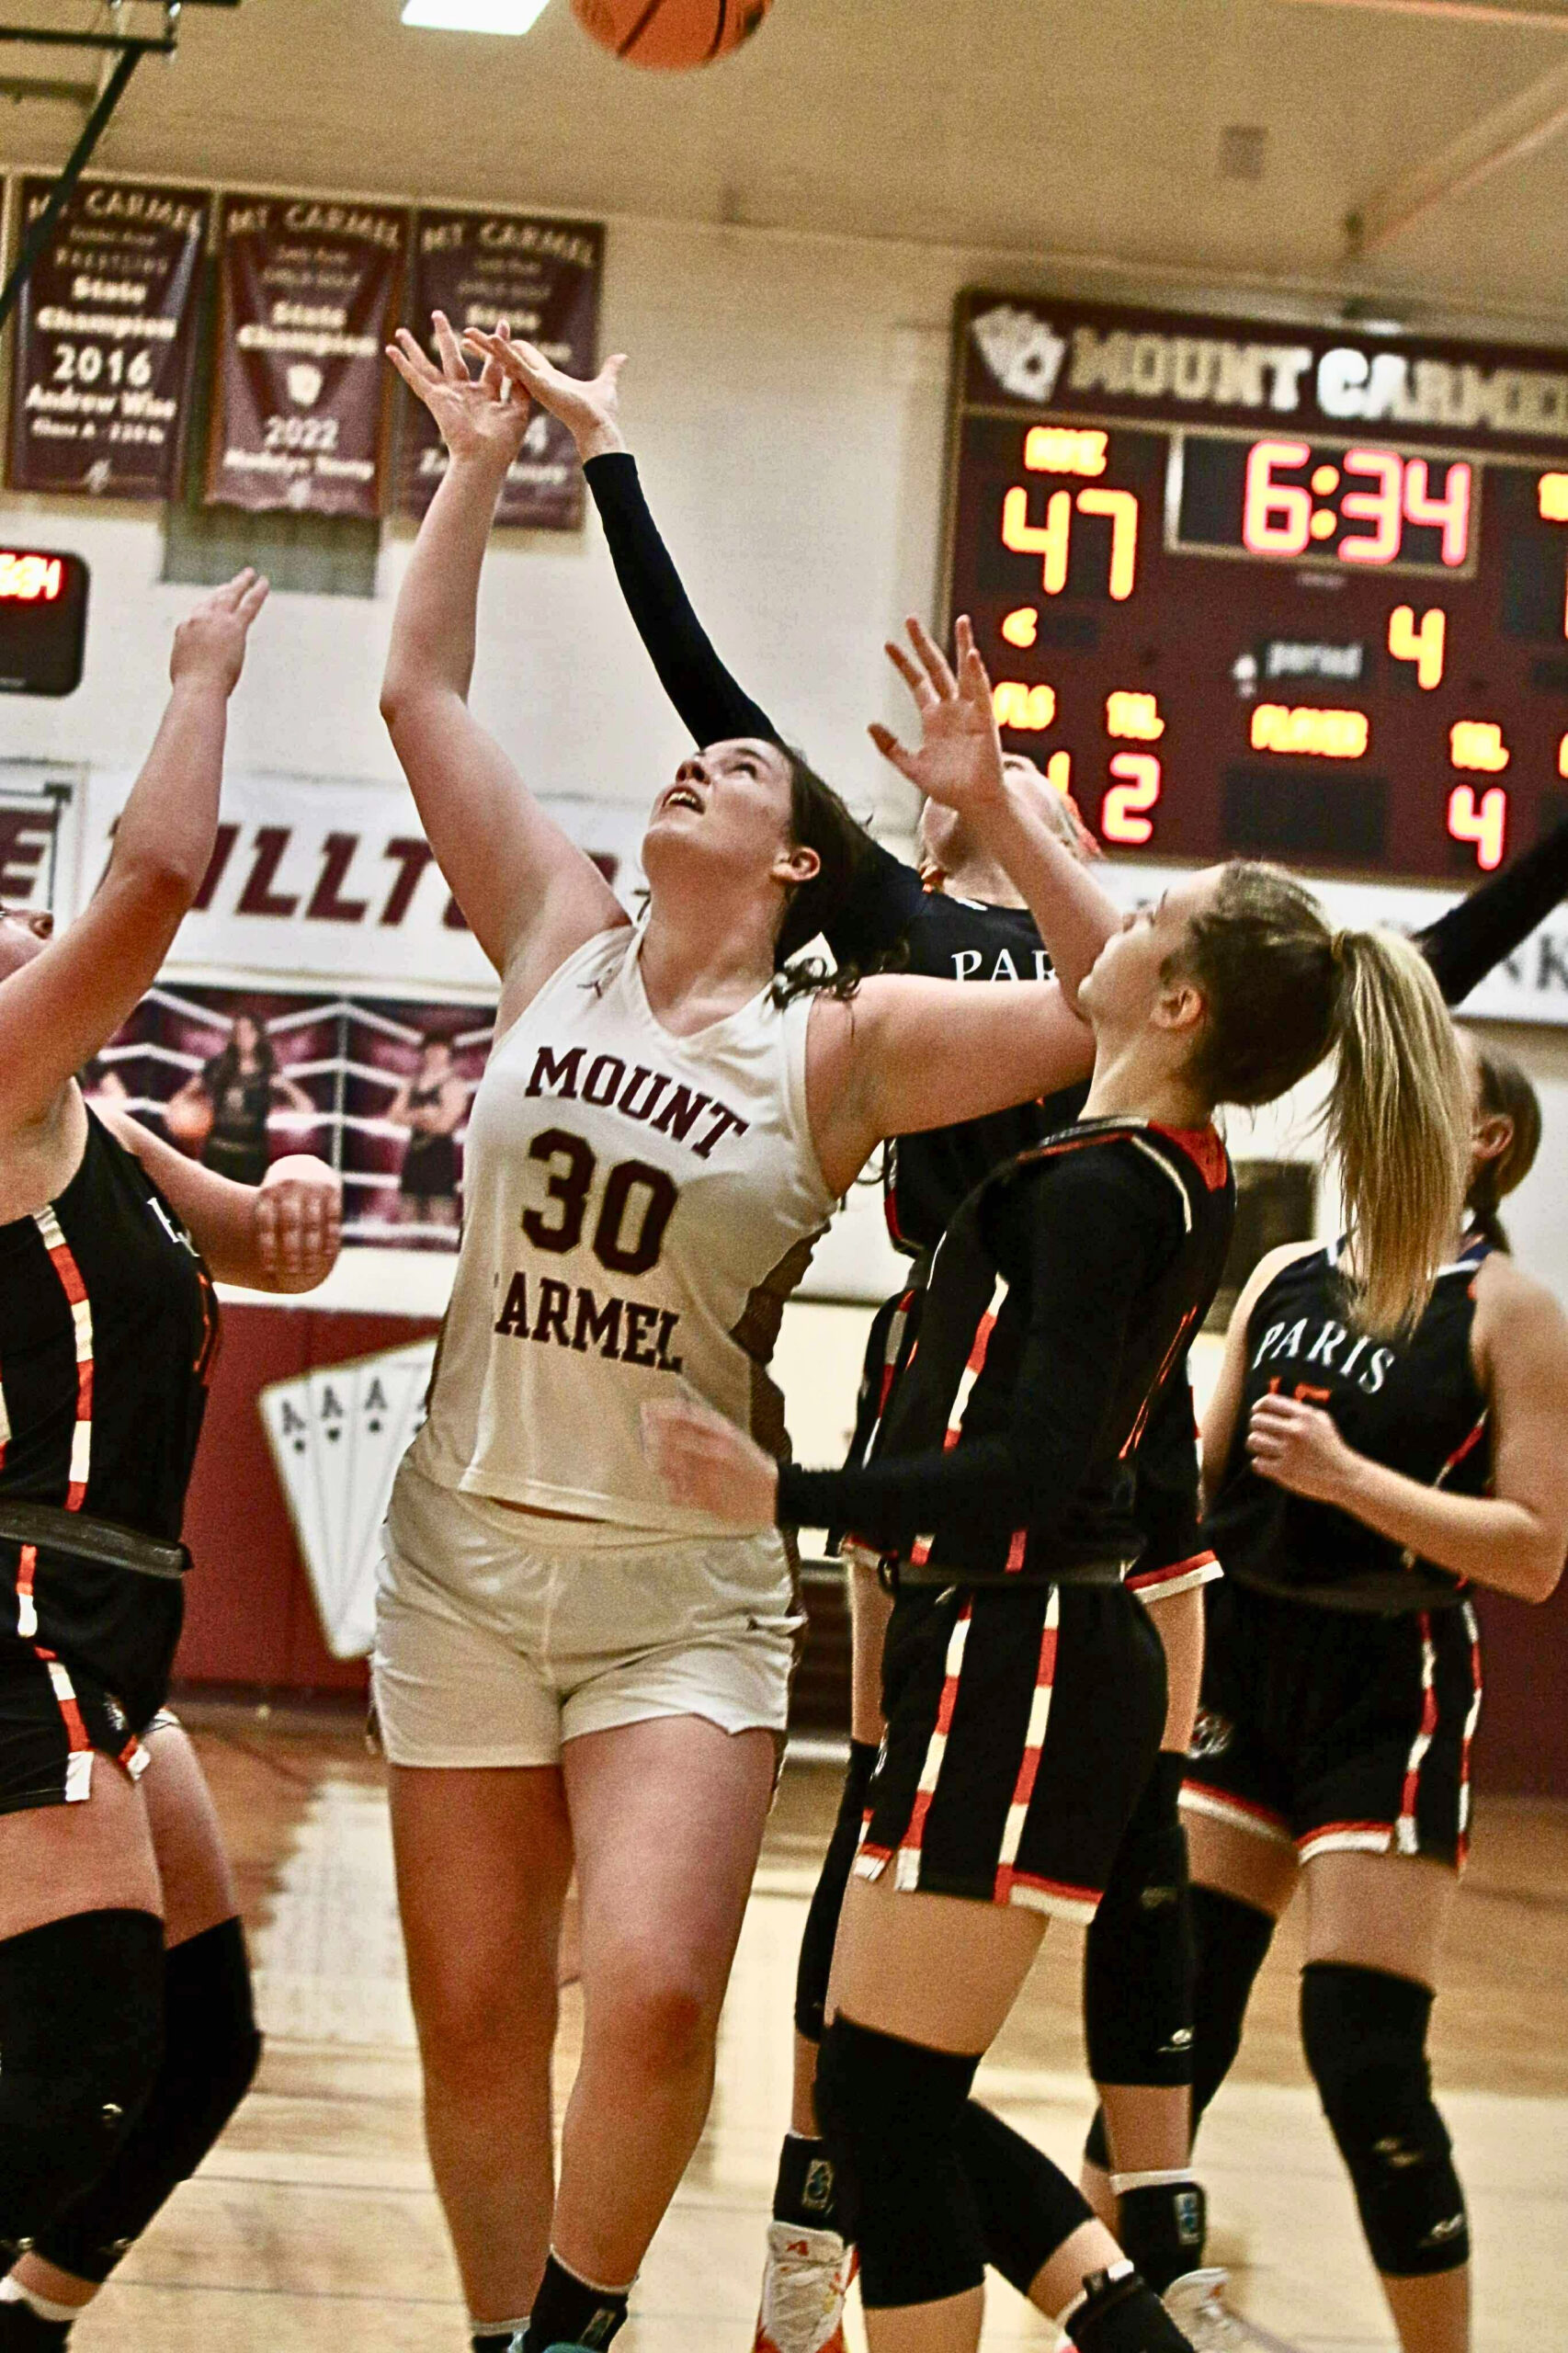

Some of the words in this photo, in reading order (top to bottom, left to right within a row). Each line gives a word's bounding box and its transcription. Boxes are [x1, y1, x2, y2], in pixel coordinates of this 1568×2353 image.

[52, 343, 153, 387] 2016
[1068, 324, 1312, 410] MOUNT
[1002, 485, 1139, 601] 47
[1244, 439, 1471, 568] 6:34
[1389, 606, 1447, 690] 4
[1103, 752, 1161, 844] 2
[1448, 785, 1506, 871] 4
[524, 1046, 750, 1161] MOUNT
[521, 1127, 678, 1278] 30
[494, 1270, 684, 1374] ARMEL
[1253, 1317, 1395, 1394] PARIS
